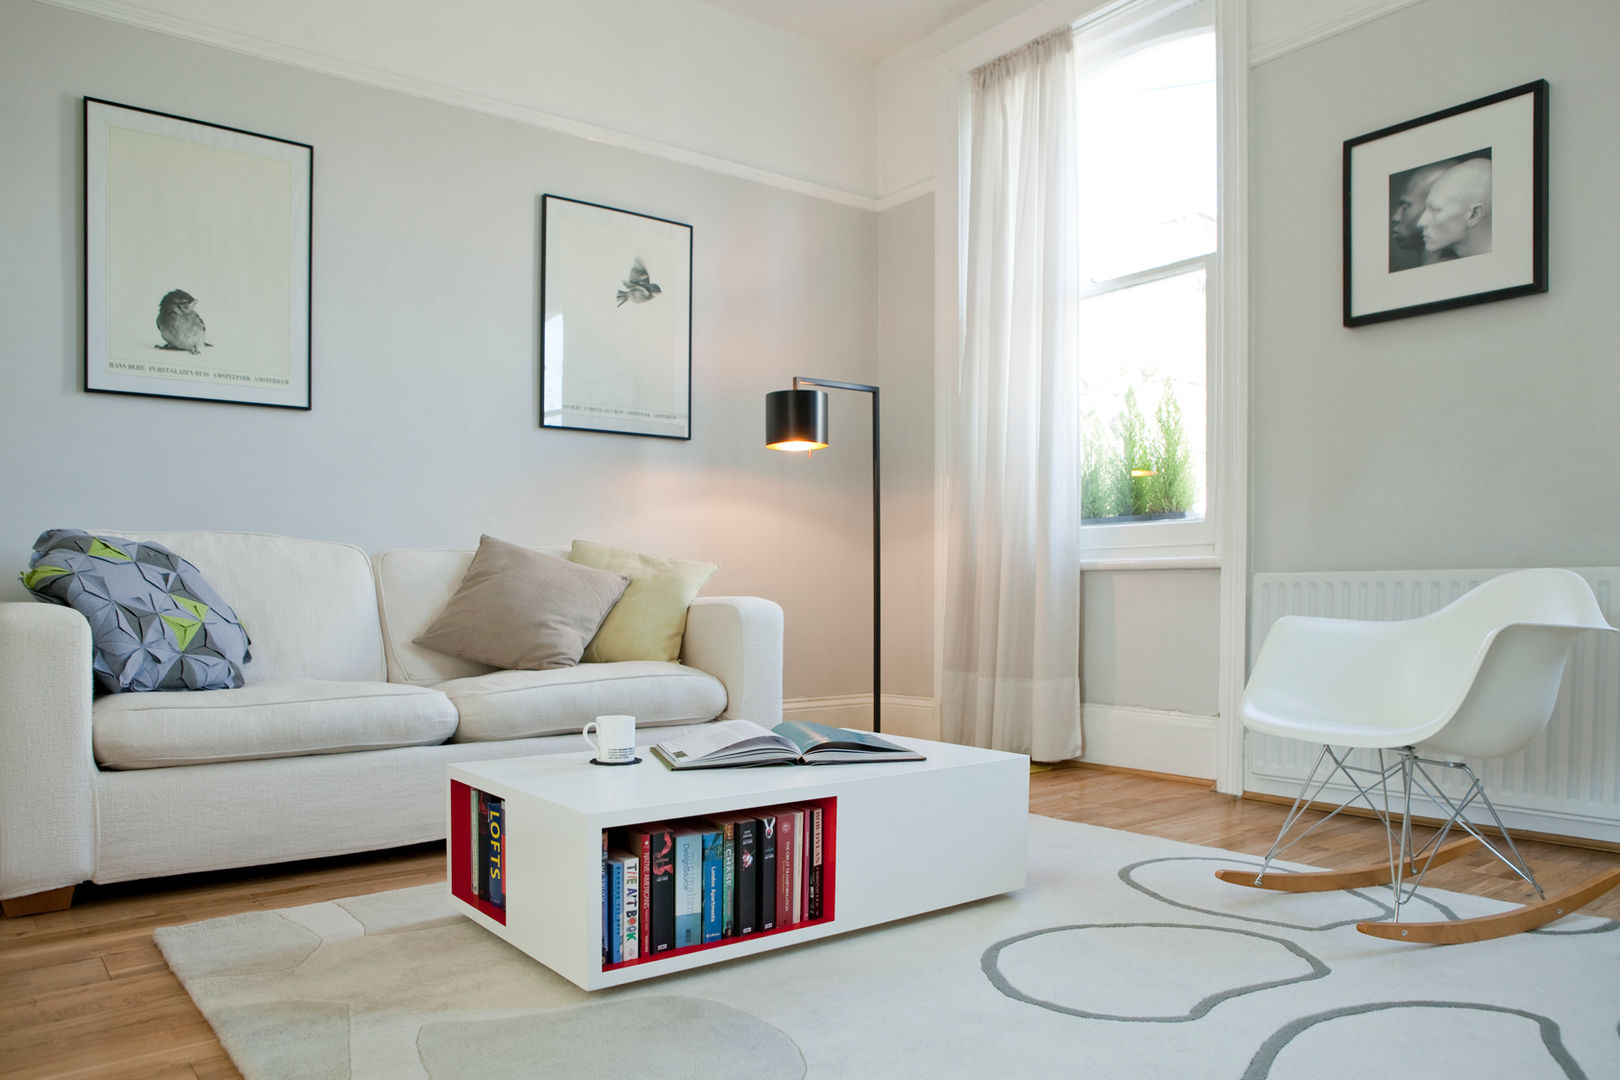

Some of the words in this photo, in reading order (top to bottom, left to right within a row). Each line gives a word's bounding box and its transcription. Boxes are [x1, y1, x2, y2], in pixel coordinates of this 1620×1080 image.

[255, 376, 289, 385] AMSTERDAM
[489, 810, 501, 880] LOFTS
[626, 863, 638, 884] THE
[626, 910, 637, 942] BOOK
